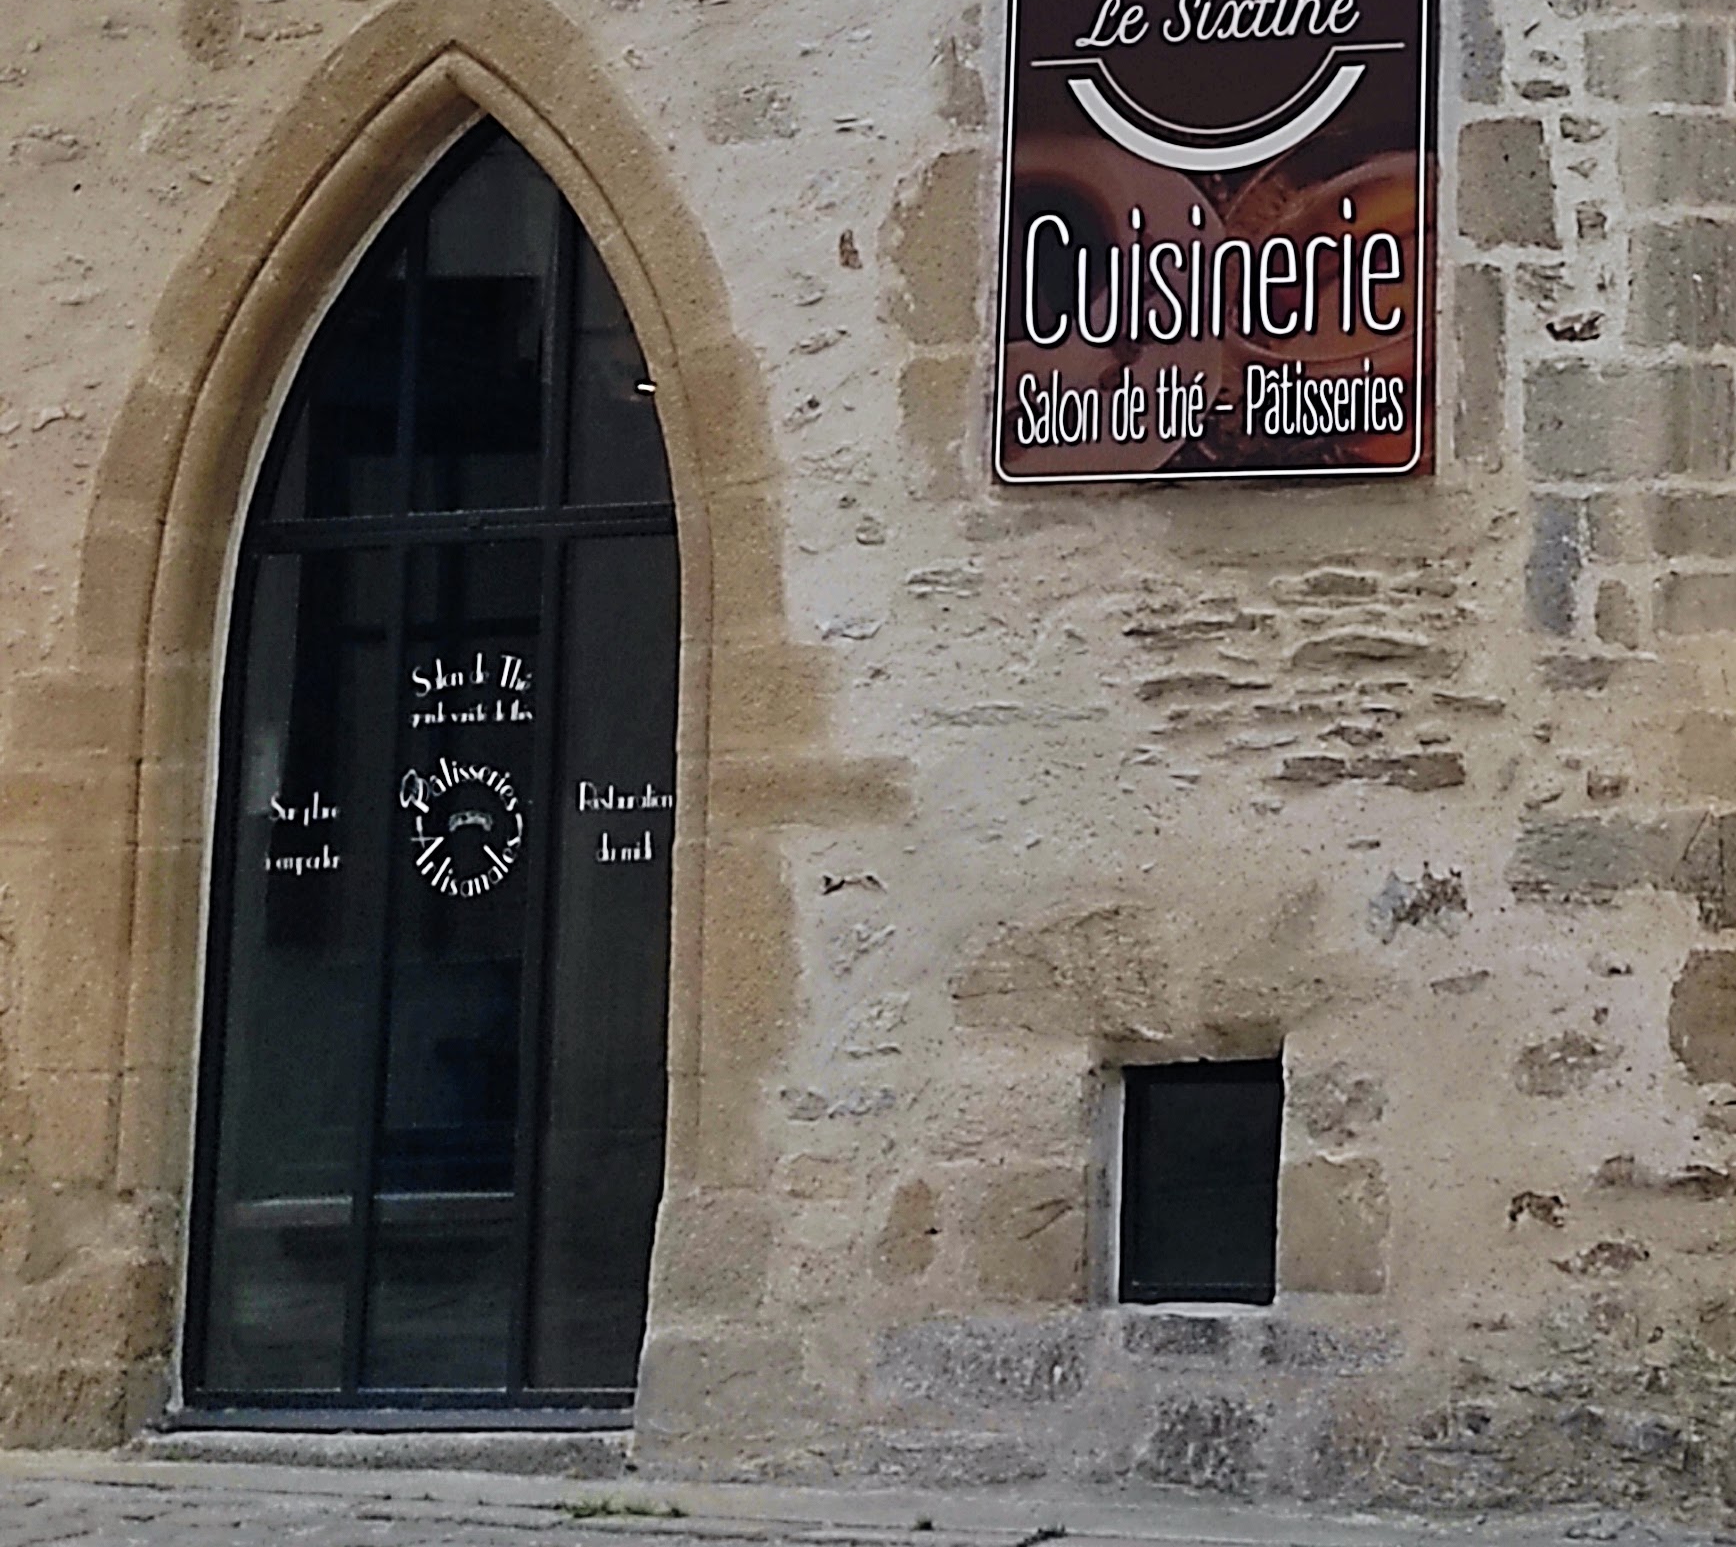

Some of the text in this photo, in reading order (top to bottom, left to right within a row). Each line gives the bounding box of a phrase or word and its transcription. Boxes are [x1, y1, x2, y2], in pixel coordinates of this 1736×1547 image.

[1025, 197, 1402, 345] Cuisinerie
[1017, 367, 1099, 445] Salon
[1111, 366, 1147, 441] de
[1155, 364, 1205, 439] thé
[1246, 357, 1404, 436] Pâtisseries
